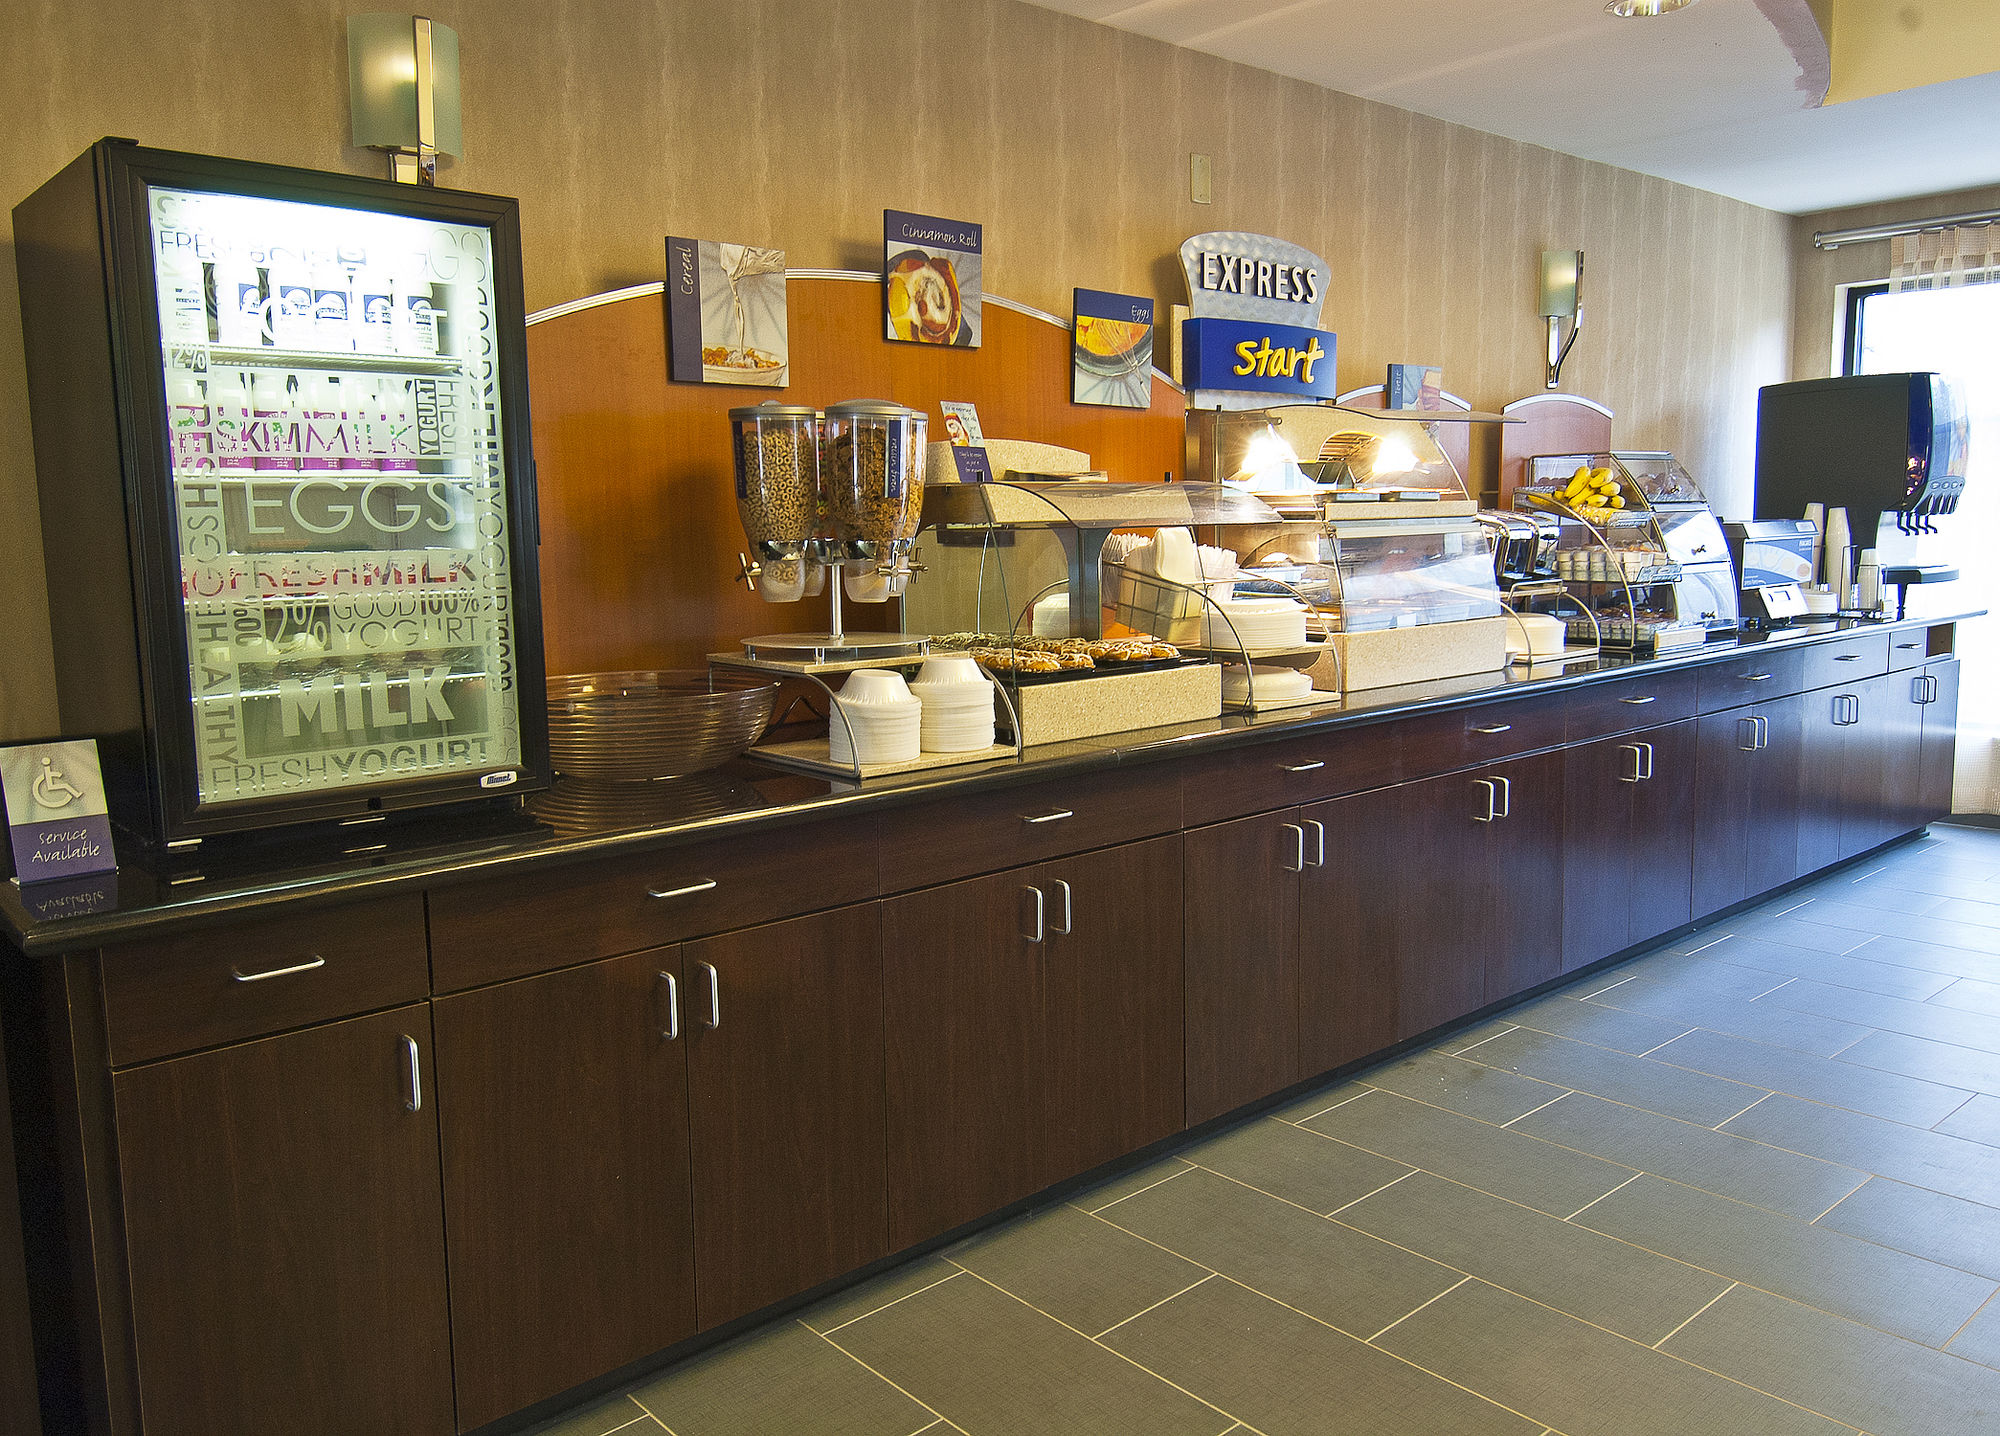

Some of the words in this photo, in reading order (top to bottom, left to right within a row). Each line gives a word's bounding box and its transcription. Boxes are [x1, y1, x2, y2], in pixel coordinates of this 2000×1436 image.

[902, 223, 956, 244] Cinnamon
[959, 232, 978, 248] Roll
[678, 246, 695, 296] Cereal
[1200, 251, 1317, 304] EXPRESS
[1130, 303, 1151, 325] Eggs
[416, 379, 441, 455] YOGURT
[245, 477, 457, 535] EGGS
[269, 597, 332, 653] 2%
[333, 590, 417, 620] GOOD
[419, 587, 479, 615] 100%
[336, 615, 480, 651] YOGURT
[279, 666, 455, 738] MILK
[212, 755, 328, 798] FRESH
[330, 736, 492, 780] YOGURT
[32, 841, 100, 863] Available
